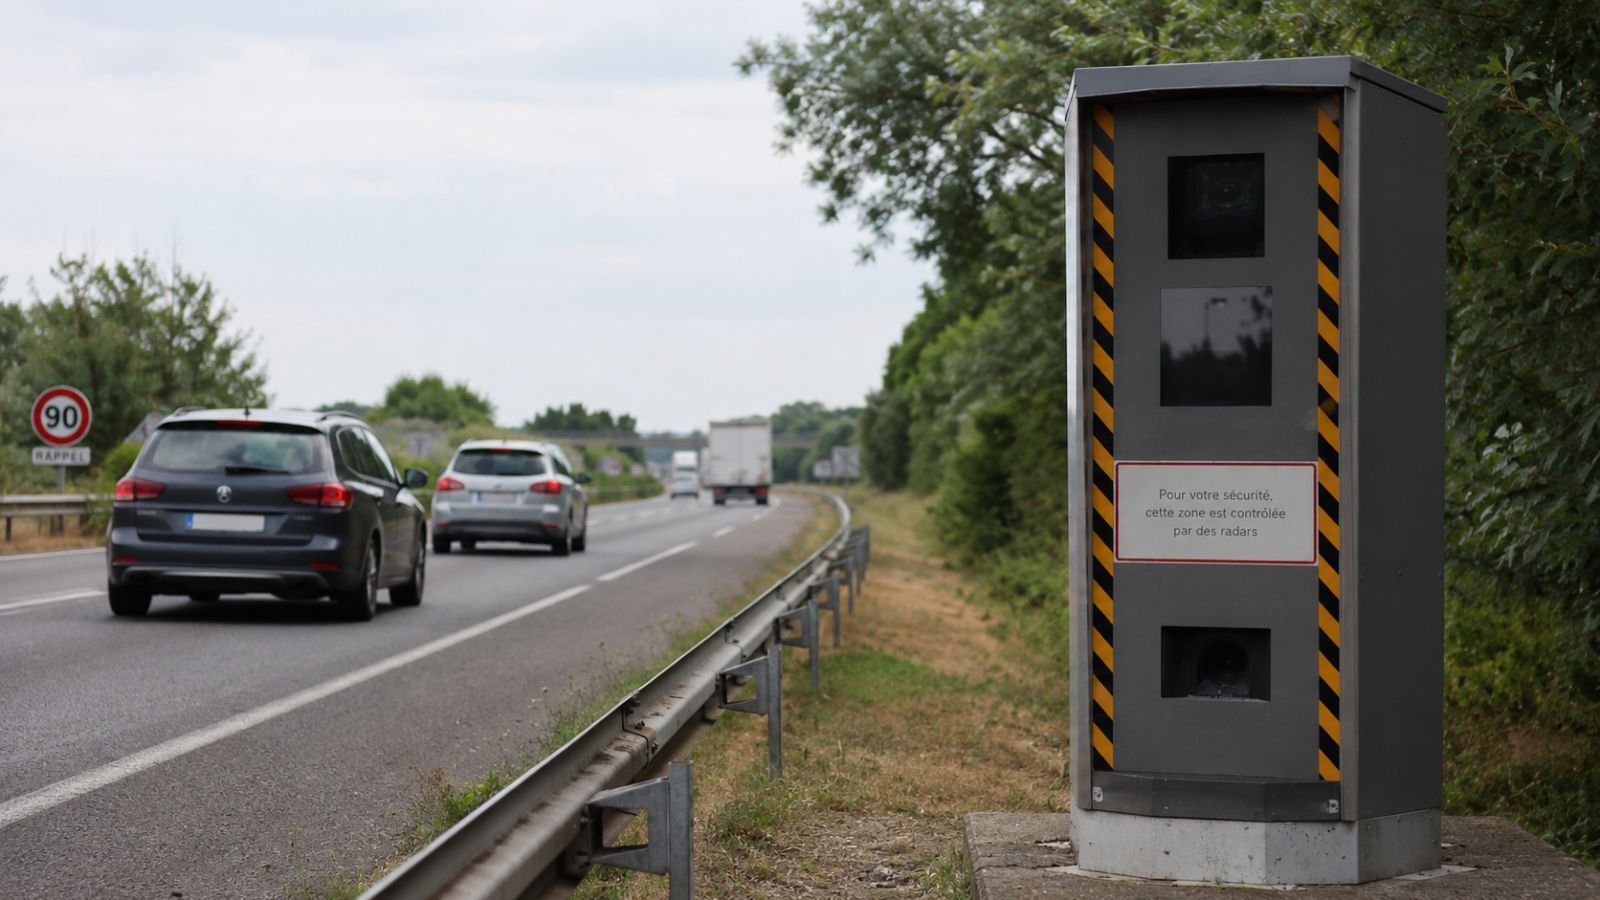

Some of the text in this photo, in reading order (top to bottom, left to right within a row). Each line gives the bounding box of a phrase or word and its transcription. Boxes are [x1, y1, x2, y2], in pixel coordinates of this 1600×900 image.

[45, 405, 78, 429] 90
[35, 450, 85, 462] RAPPEL
[1159, 488, 1273, 502] Pour votre sécurité,
[1145, 507, 1286, 519] cette zone est contrôlée
[1173, 525, 1258, 538] par des radars
